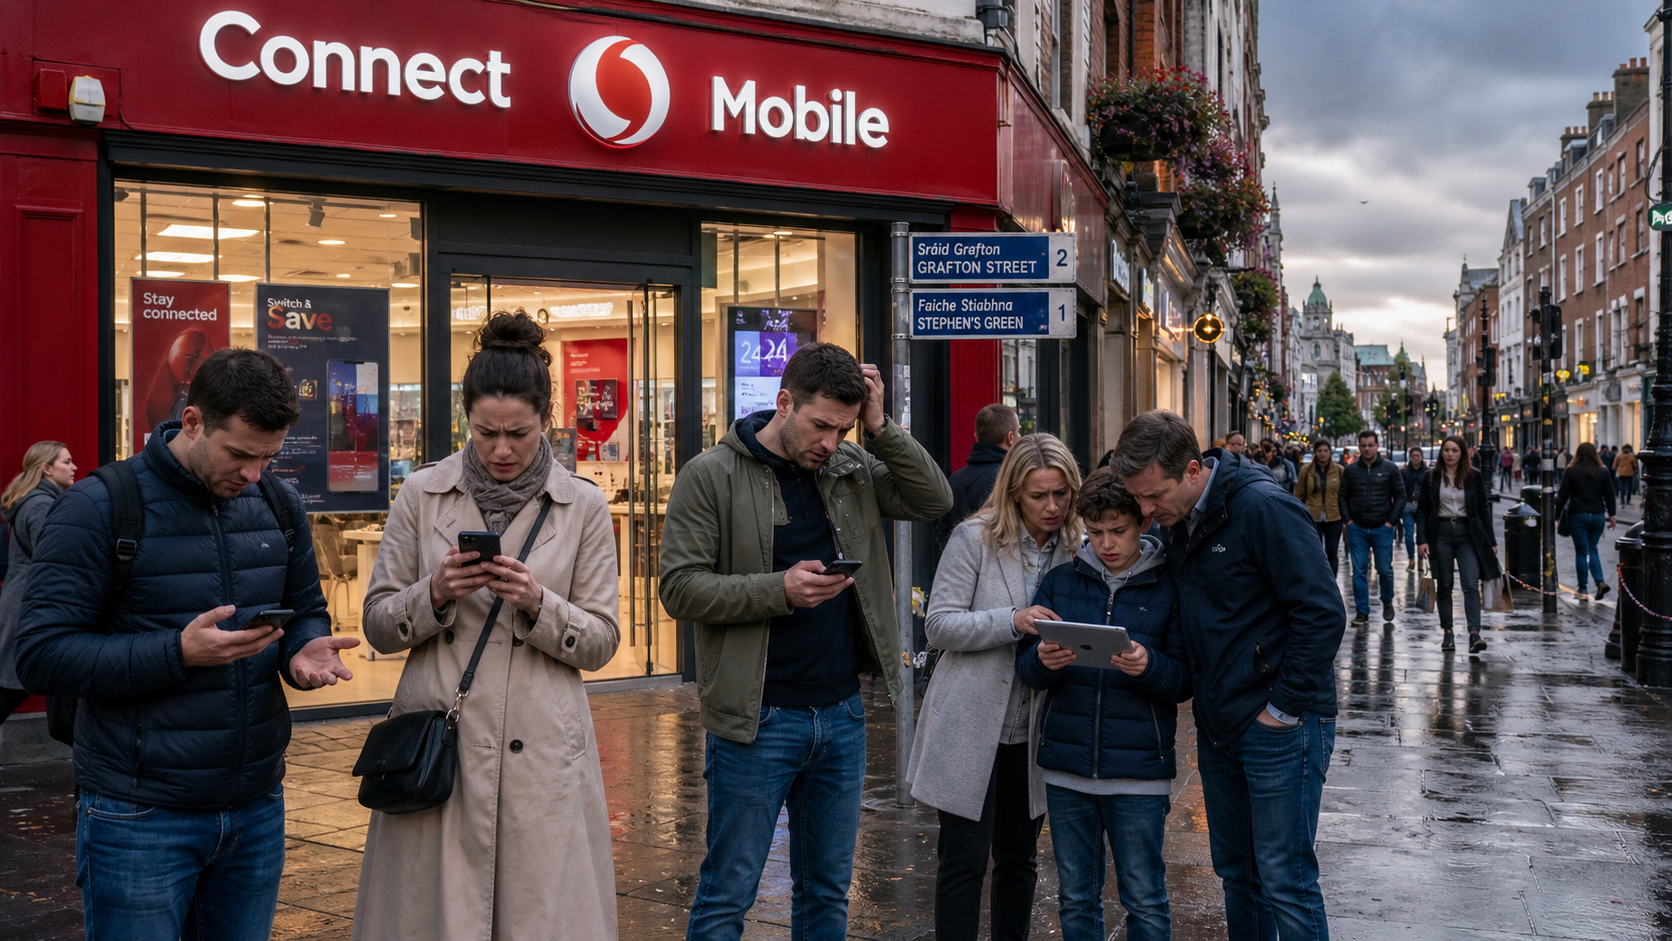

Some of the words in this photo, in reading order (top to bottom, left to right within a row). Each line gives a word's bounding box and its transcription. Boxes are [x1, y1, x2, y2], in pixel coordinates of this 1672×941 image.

[199, 10, 512, 108] Connect
[711, 76, 890, 149] Mobile
[917, 243, 950, 255] Sráid
[1056, 249, 1068, 267] 2
[917, 261, 981, 273] GRAFTON
[986, 261, 1037, 274] STREET
[143, 292, 175, 308] Stay
[267, 298, 303, 309] Switch
[918, 299, 957, 312] Faiche
[961, 299, 1013, 312] Stiabhna
[143, 308, 218, 322] connected
[267, 305, 333, 331] Save
[1058, 304, 1066, 322] 1
[917, 316, 981, 330] STEPHEN'S
[984, 316, 1024, 330] GREEN
